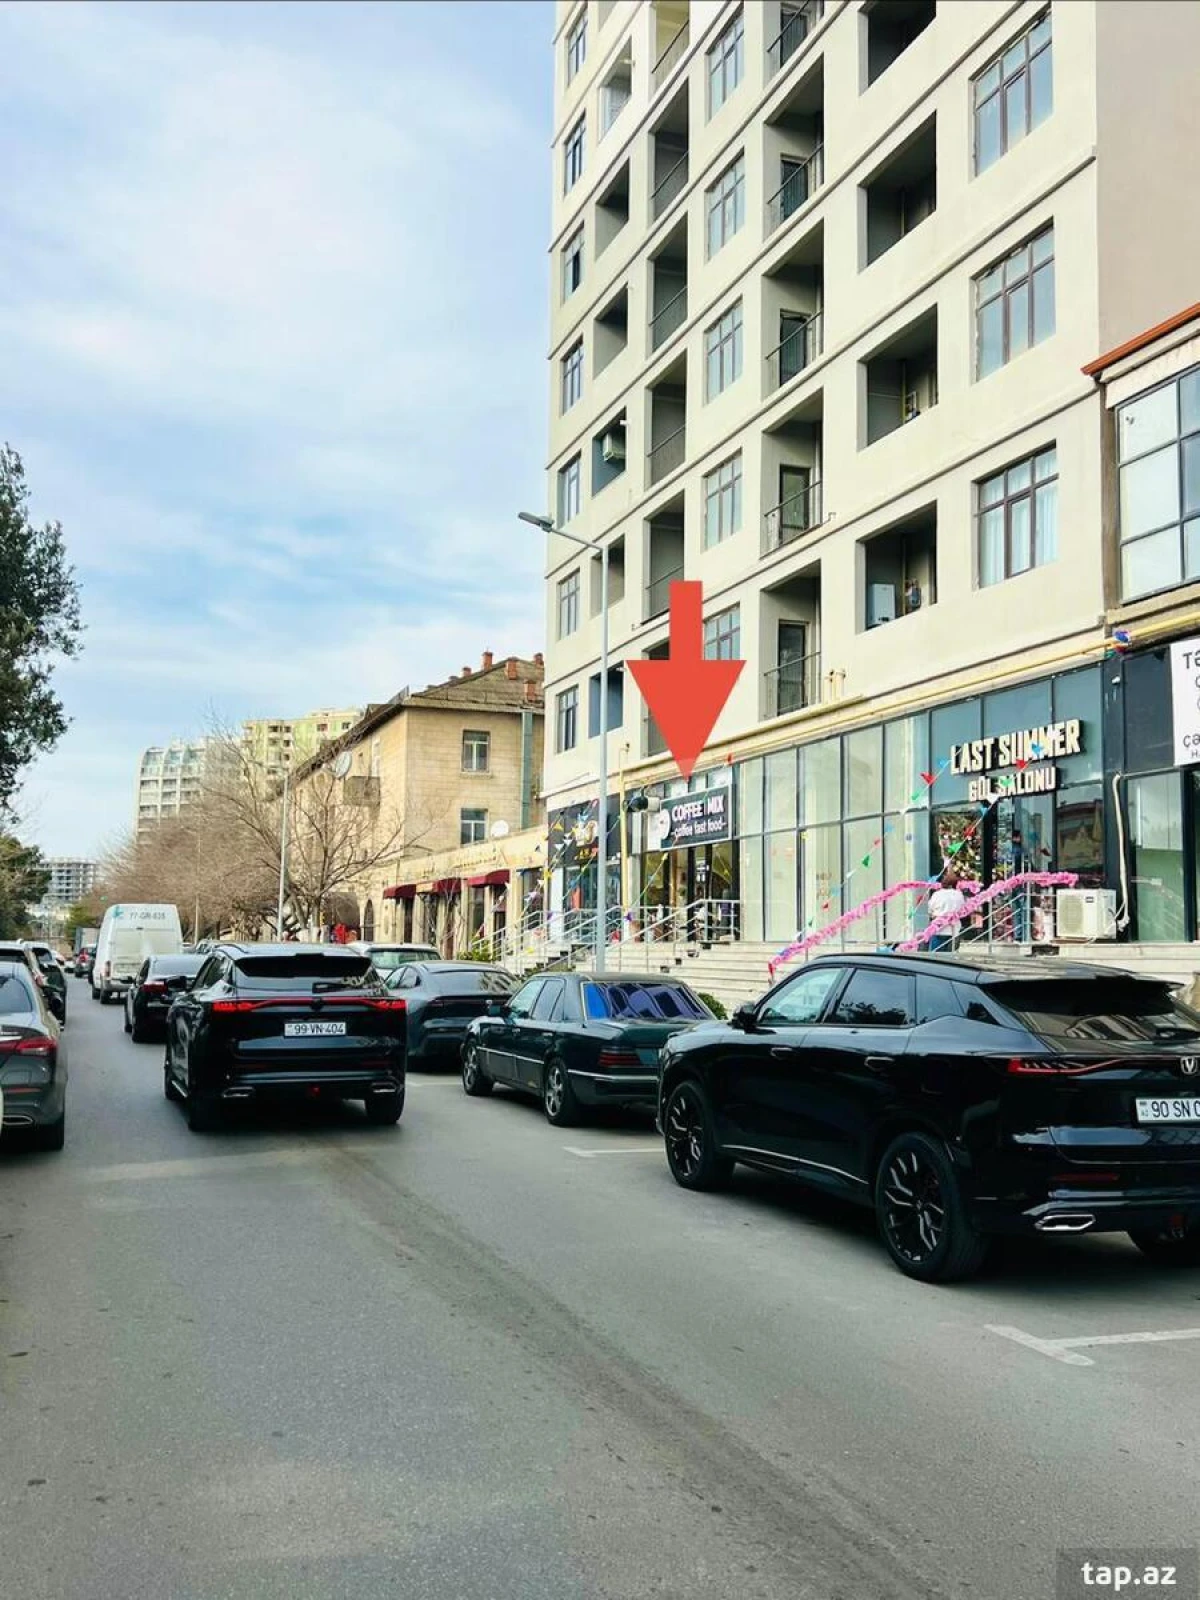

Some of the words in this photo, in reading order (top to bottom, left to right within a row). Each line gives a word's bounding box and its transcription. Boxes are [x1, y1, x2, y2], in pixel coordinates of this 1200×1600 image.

[951, 738, 995, 775] LAST
[999, 719, 1081, 767] SUMMER
[671, 800, 704, 822] COFFEE
[708, 795, 724, 815] MIX
[1151, 1100, 1169, 1118] 90
[1173, 1100, 1191, 1118] SN
